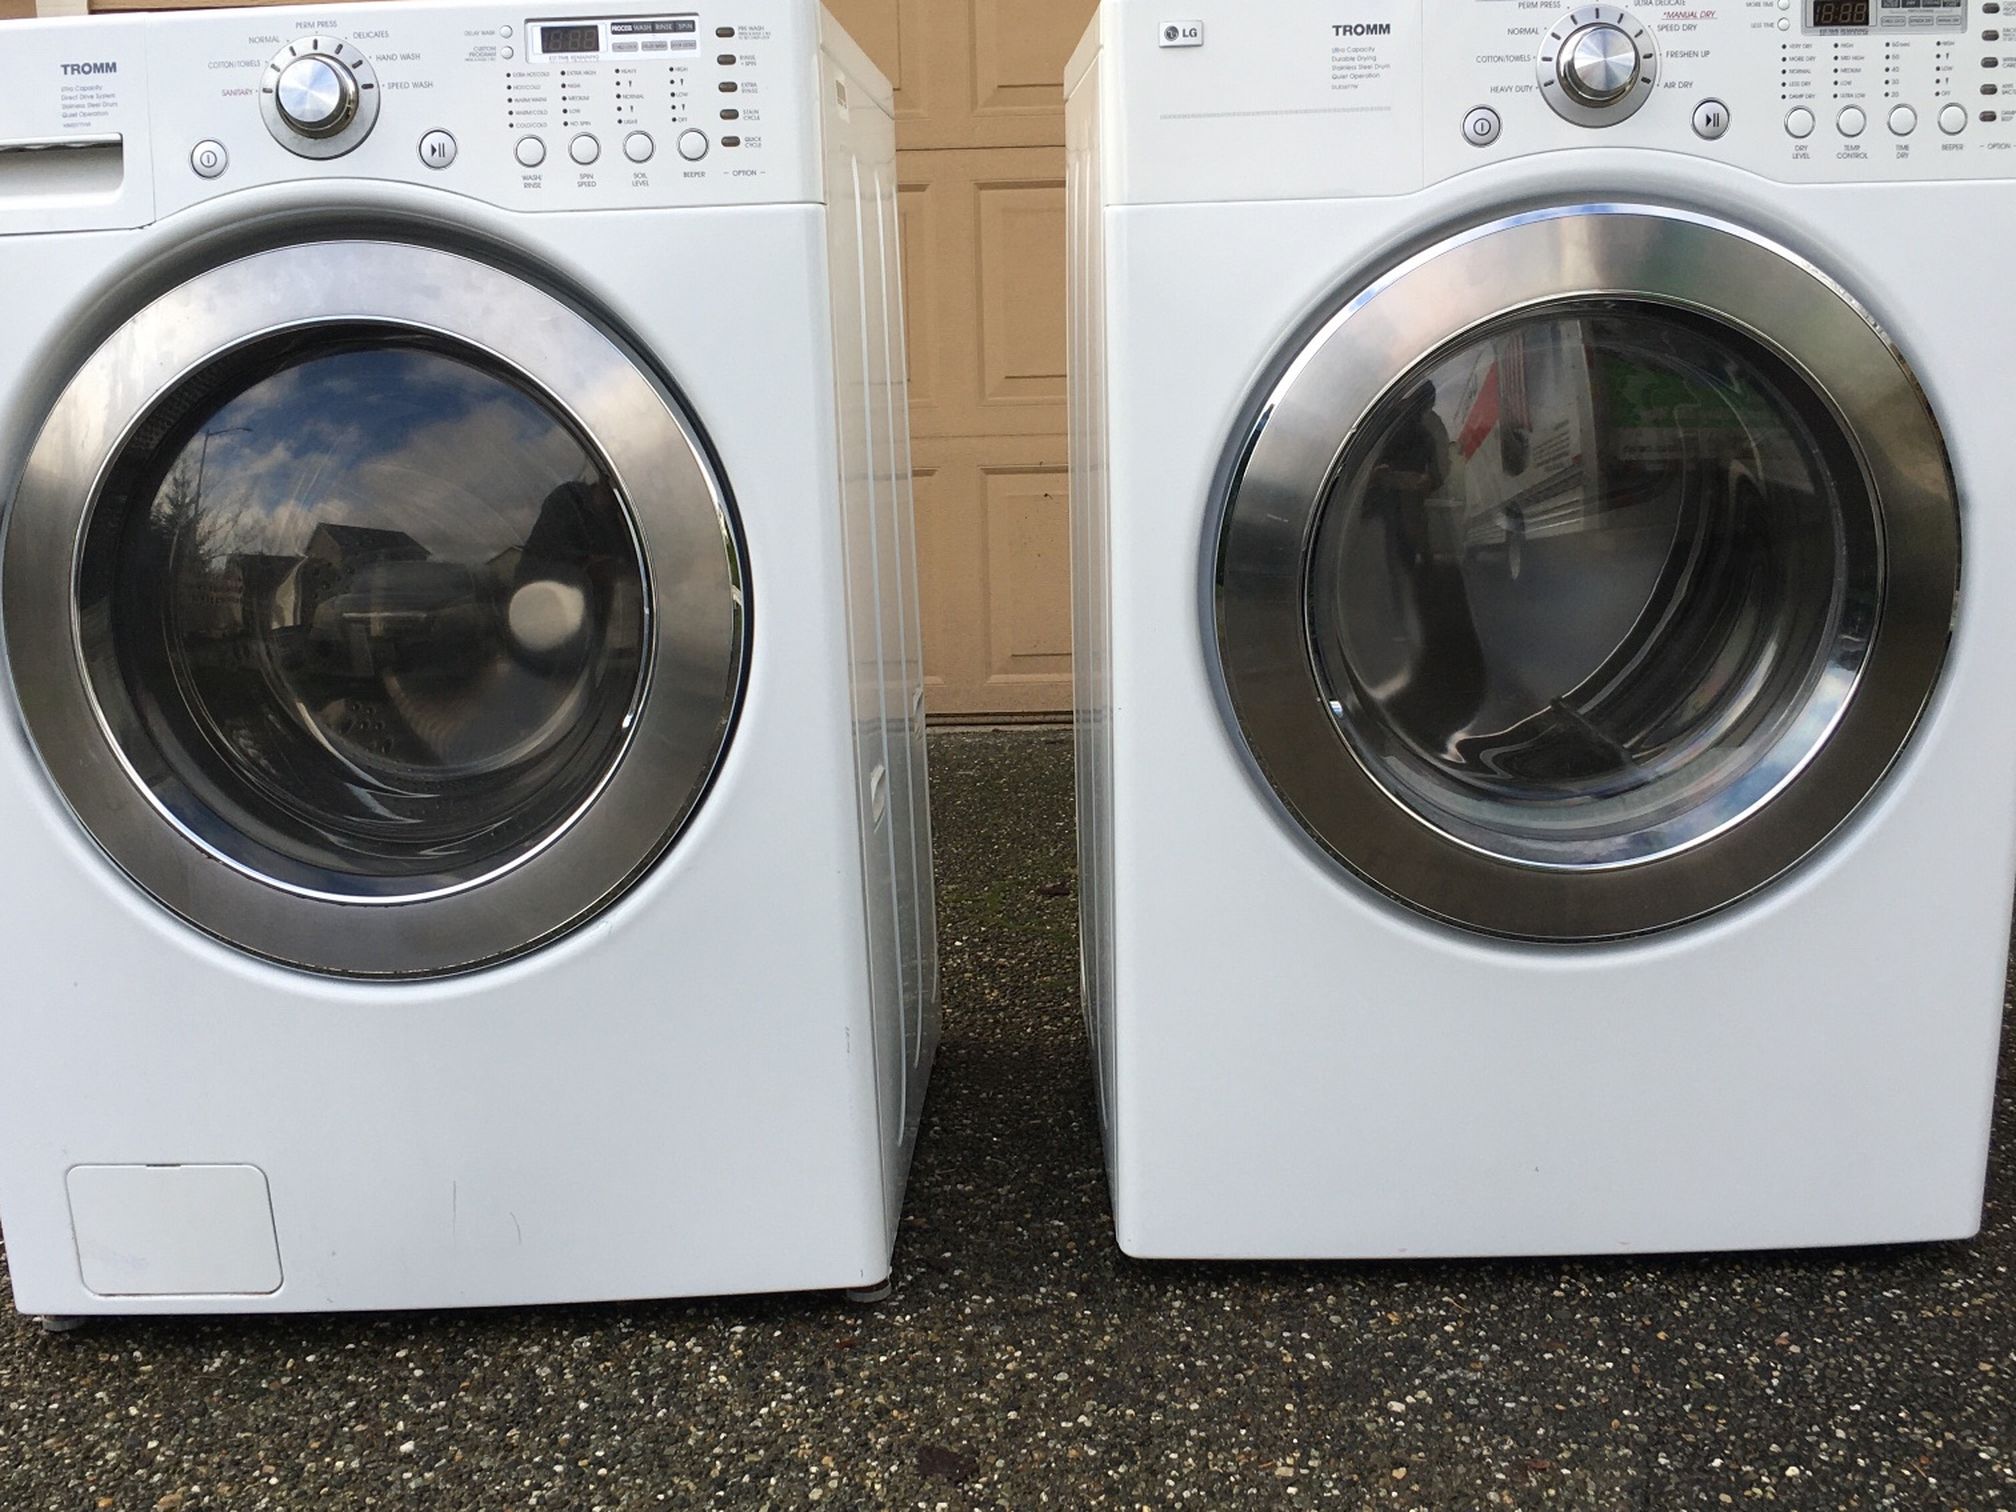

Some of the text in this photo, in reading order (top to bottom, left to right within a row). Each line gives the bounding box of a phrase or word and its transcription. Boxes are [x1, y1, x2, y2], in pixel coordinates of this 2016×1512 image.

[633, 24, 652, 32] WASH
[1332, 24, 1390, 36] TROMM
[1657, 24, 1680, 32] SPEED
[352, 31, 389, 39] DELICATES
[1182, 28, 1198, 38] LG
[248, 36, 280, 44] NORMAL
[60, 62, 117, 75] TROMM
[388, 80, 434, 90] SPEED WASH
